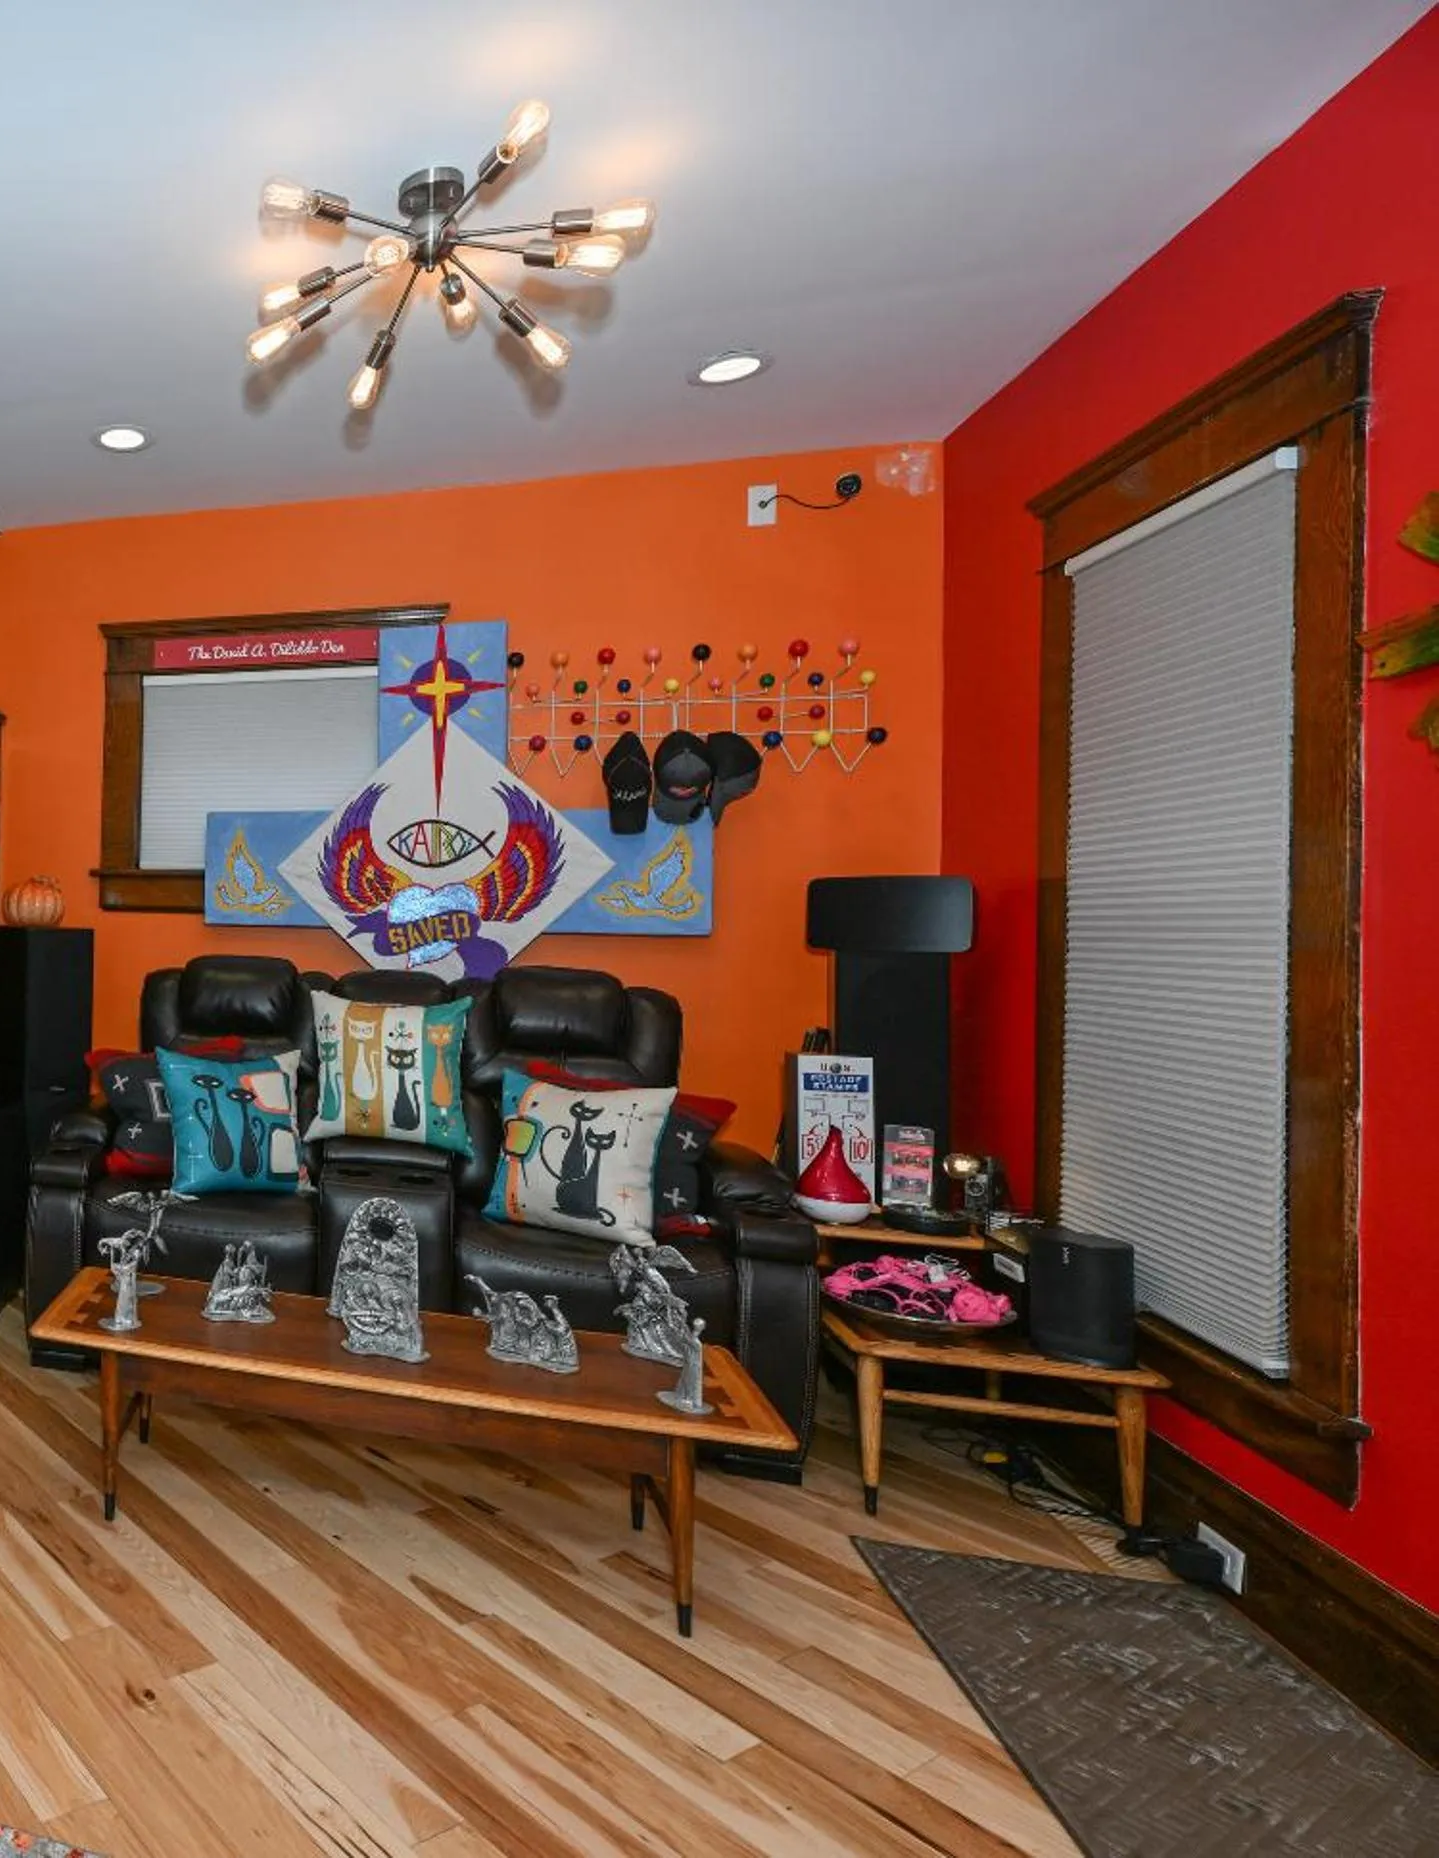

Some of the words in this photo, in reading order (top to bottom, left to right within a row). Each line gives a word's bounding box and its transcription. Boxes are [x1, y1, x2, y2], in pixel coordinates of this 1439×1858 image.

[188, 646, 212, 660] The
[212, 643, 250, 659] David
[388, 913, 471, 953] SAVED
